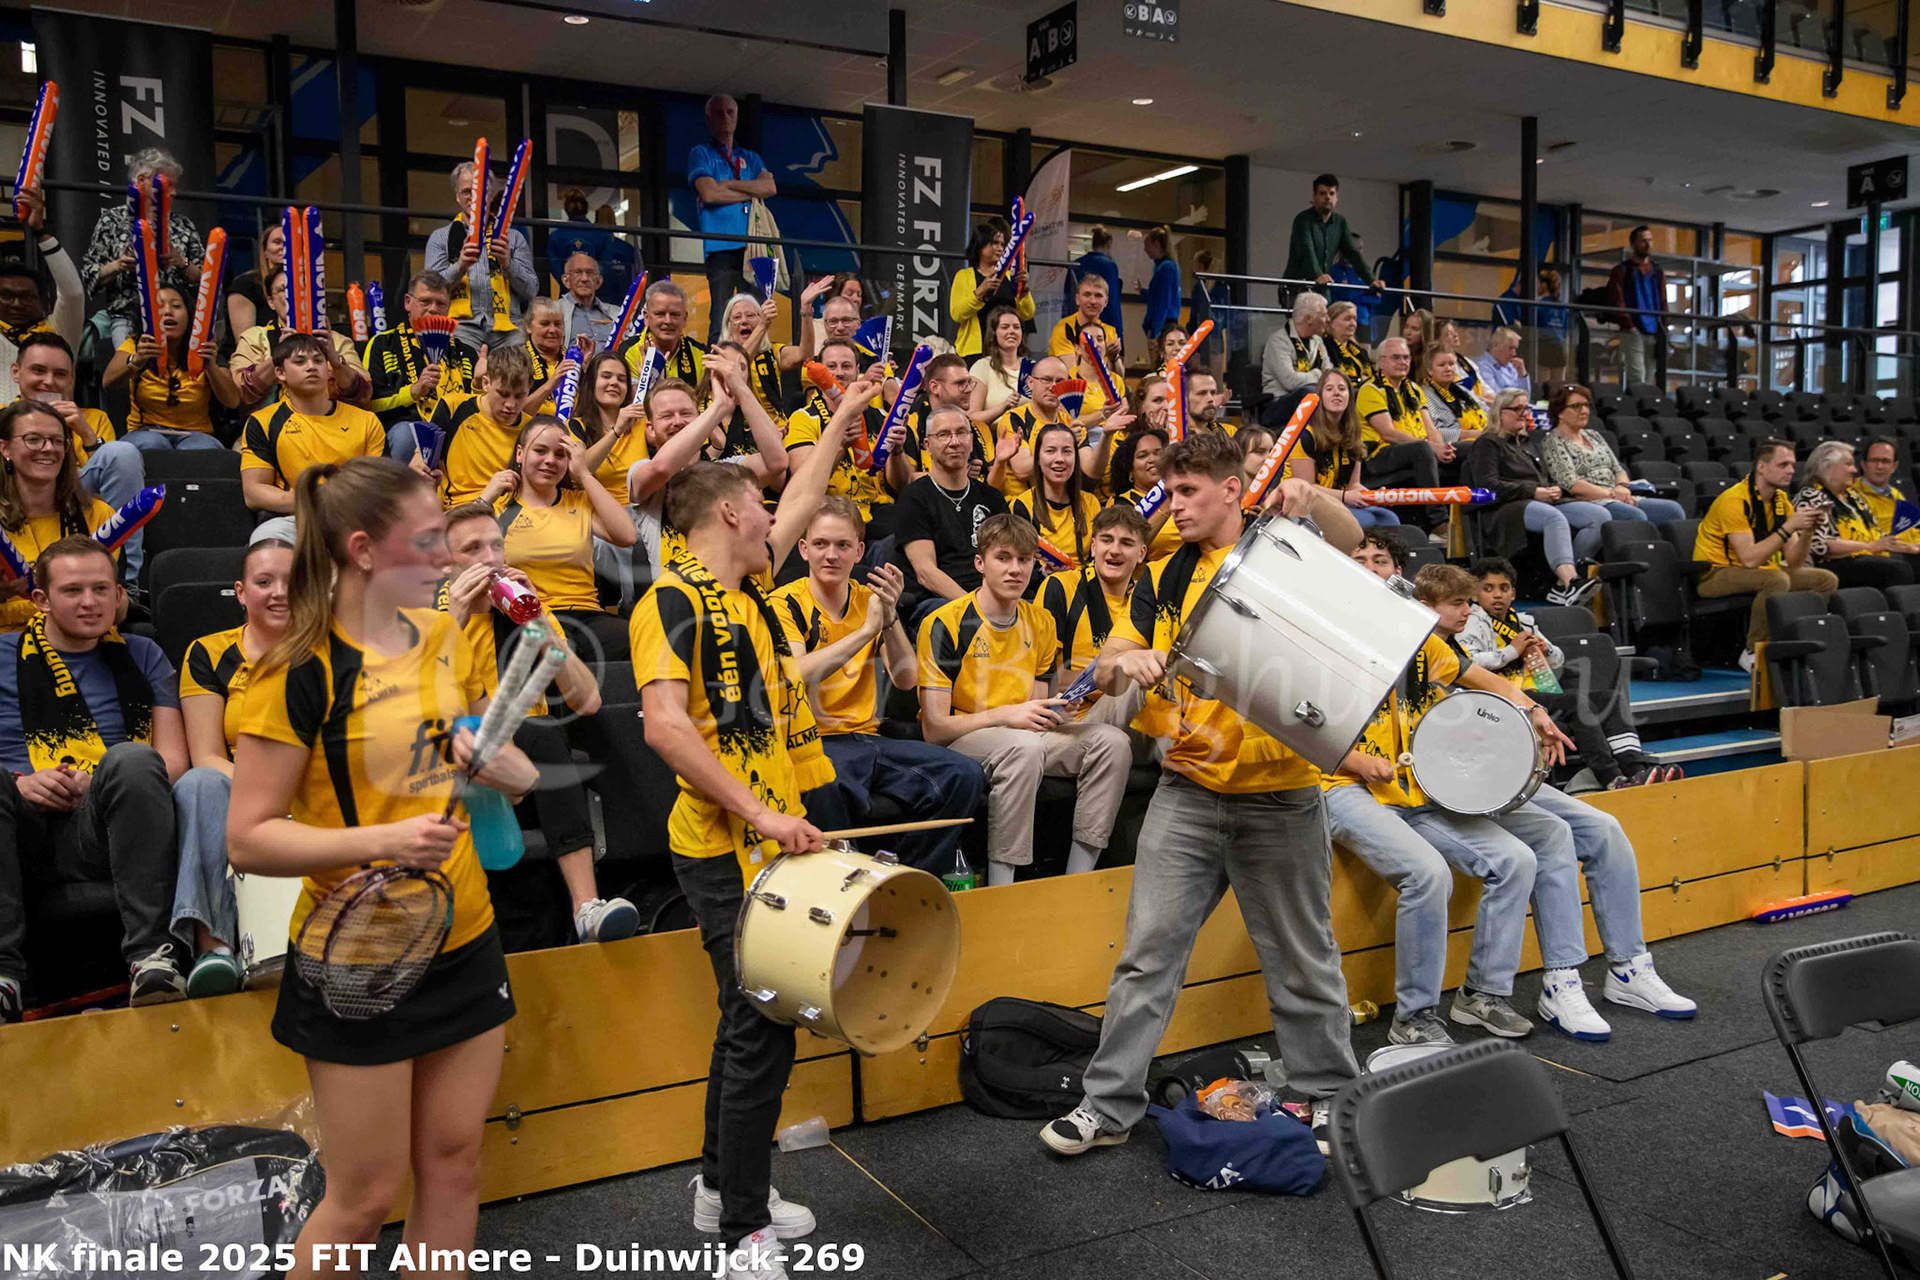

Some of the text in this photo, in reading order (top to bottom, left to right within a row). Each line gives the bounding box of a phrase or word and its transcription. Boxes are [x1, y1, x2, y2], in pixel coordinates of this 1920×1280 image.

[1138, 5, 1165, 25] B A
[1029, 27, 1059, 62] A B
[93, 70, 111, 171] INNOVATED
[119, 75, 166, 139] FZ
[896, 153, 907, 235] INNOVATED
[913, 155, 942, 208] FZ
[1860, 176, 1875, 194] A
[188, 269, 213, 351] VICTOR
[896, 263, 906, 331] DENMARK
[883, 326, 891, 355] VICTOR
[558, 360, 583, 411] VICTOR
[639, 359, 652, 394] VICTOR
[1249, 423, 1298, 493] VICTOR
[1374, 489, 1435, 503] VICTOR
[698, 582, 734, 647] voor
[716, 650, 742, 703] één
[785, 727, 821, 750] ALME
[185, 1173, 289, 1213] FORZA
